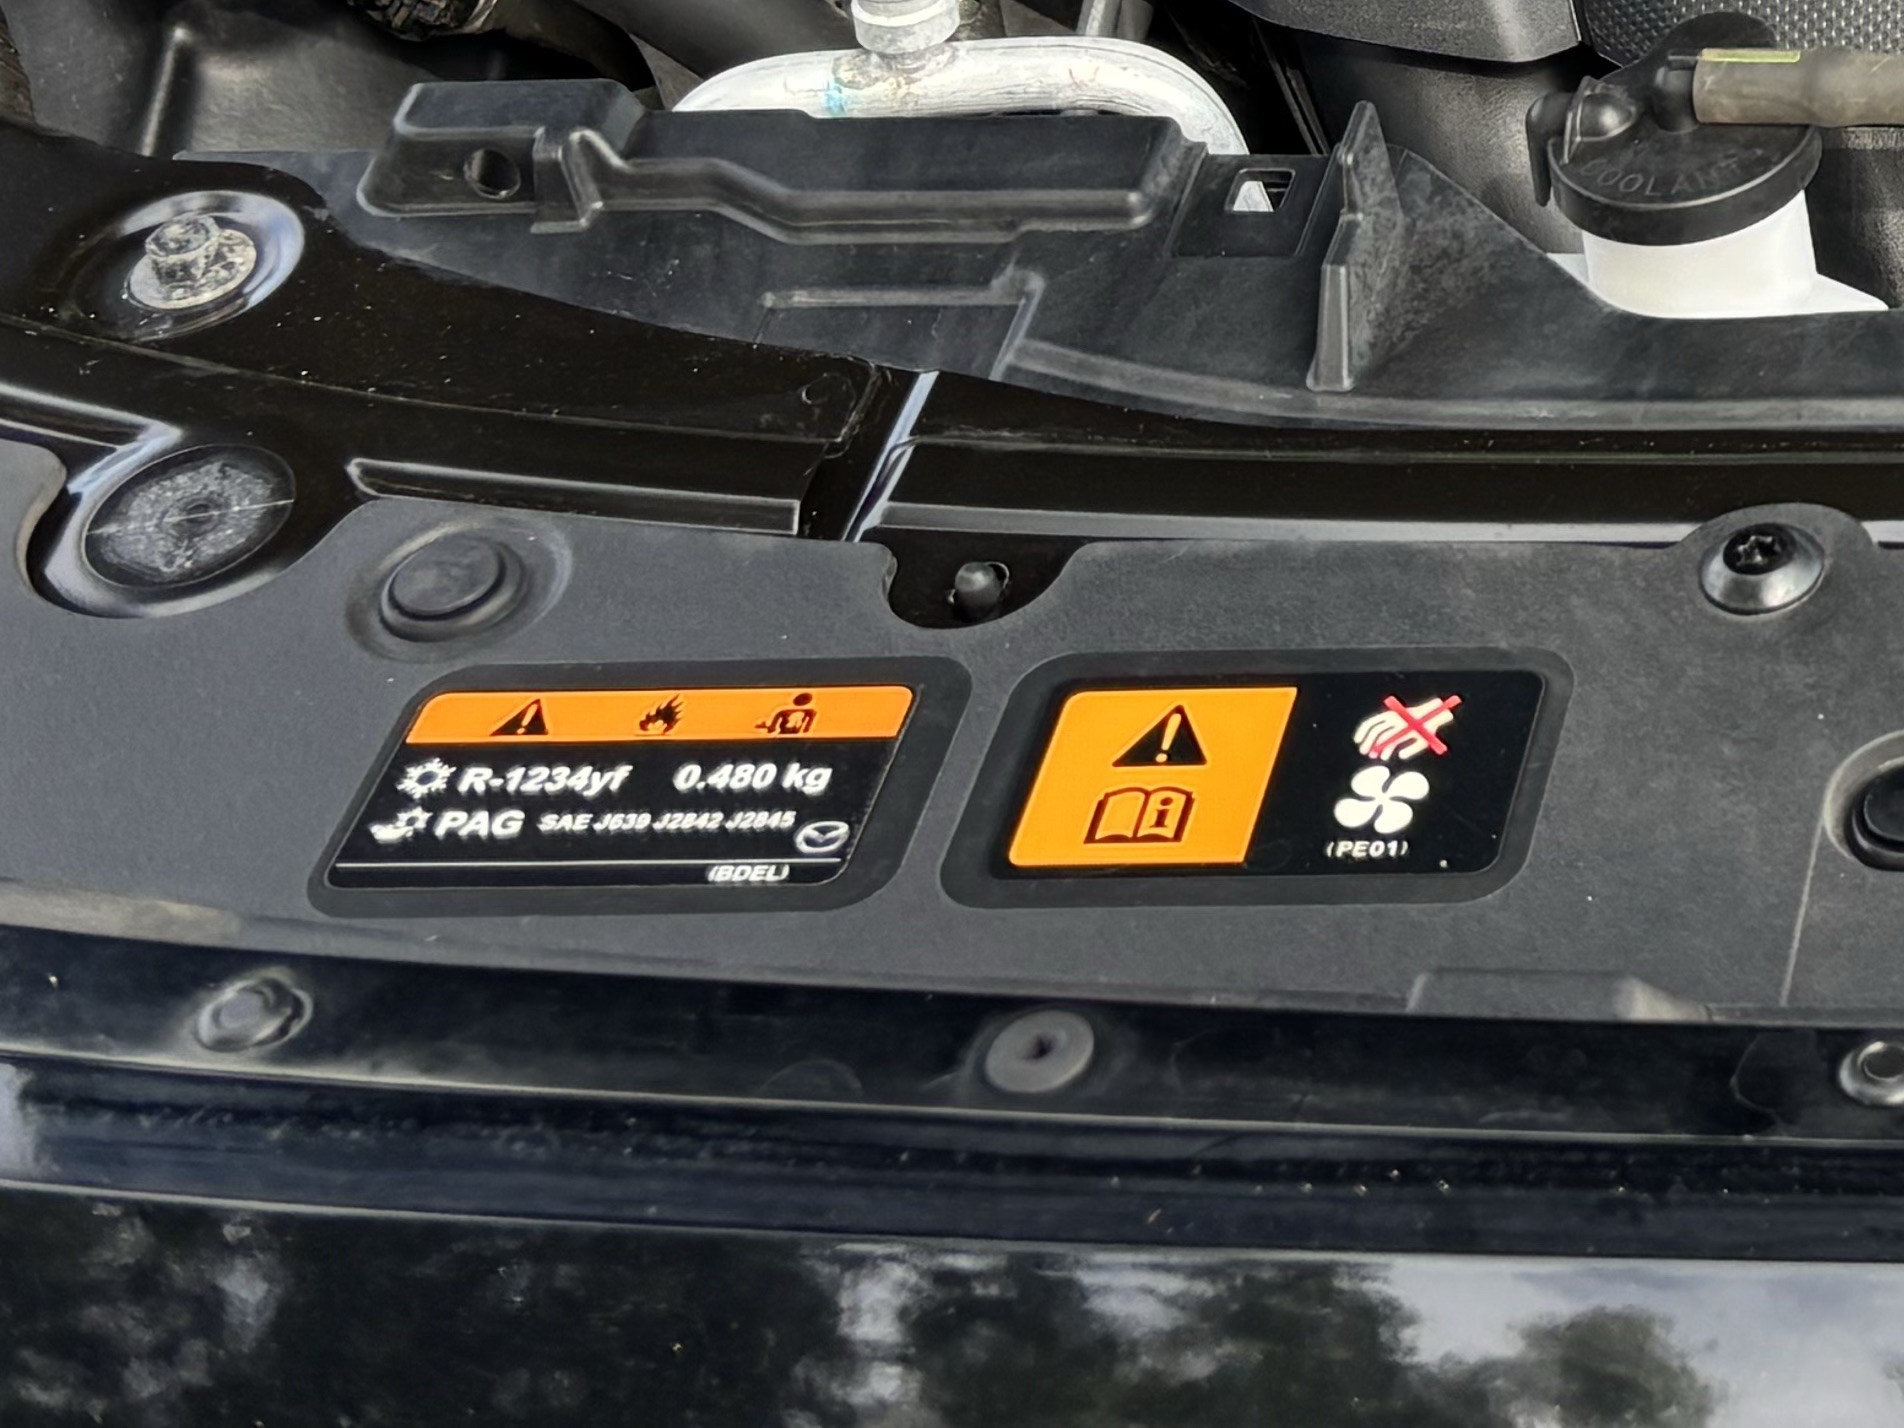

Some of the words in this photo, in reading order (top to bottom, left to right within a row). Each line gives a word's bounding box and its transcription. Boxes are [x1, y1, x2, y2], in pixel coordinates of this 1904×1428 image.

[456, 764, 633, 795] R-1234yf
[673, 763, 779, 792] 0.480
[784, 763, 832, 795] kg
[433, 809, 526, 839] PAG
[538, 813, 595, 832] SAE
[592, 812, 652, 831] J639
[1325, 839, 1409, 858] (PE01)
[707, 864, 790, 883] (BDEL)
